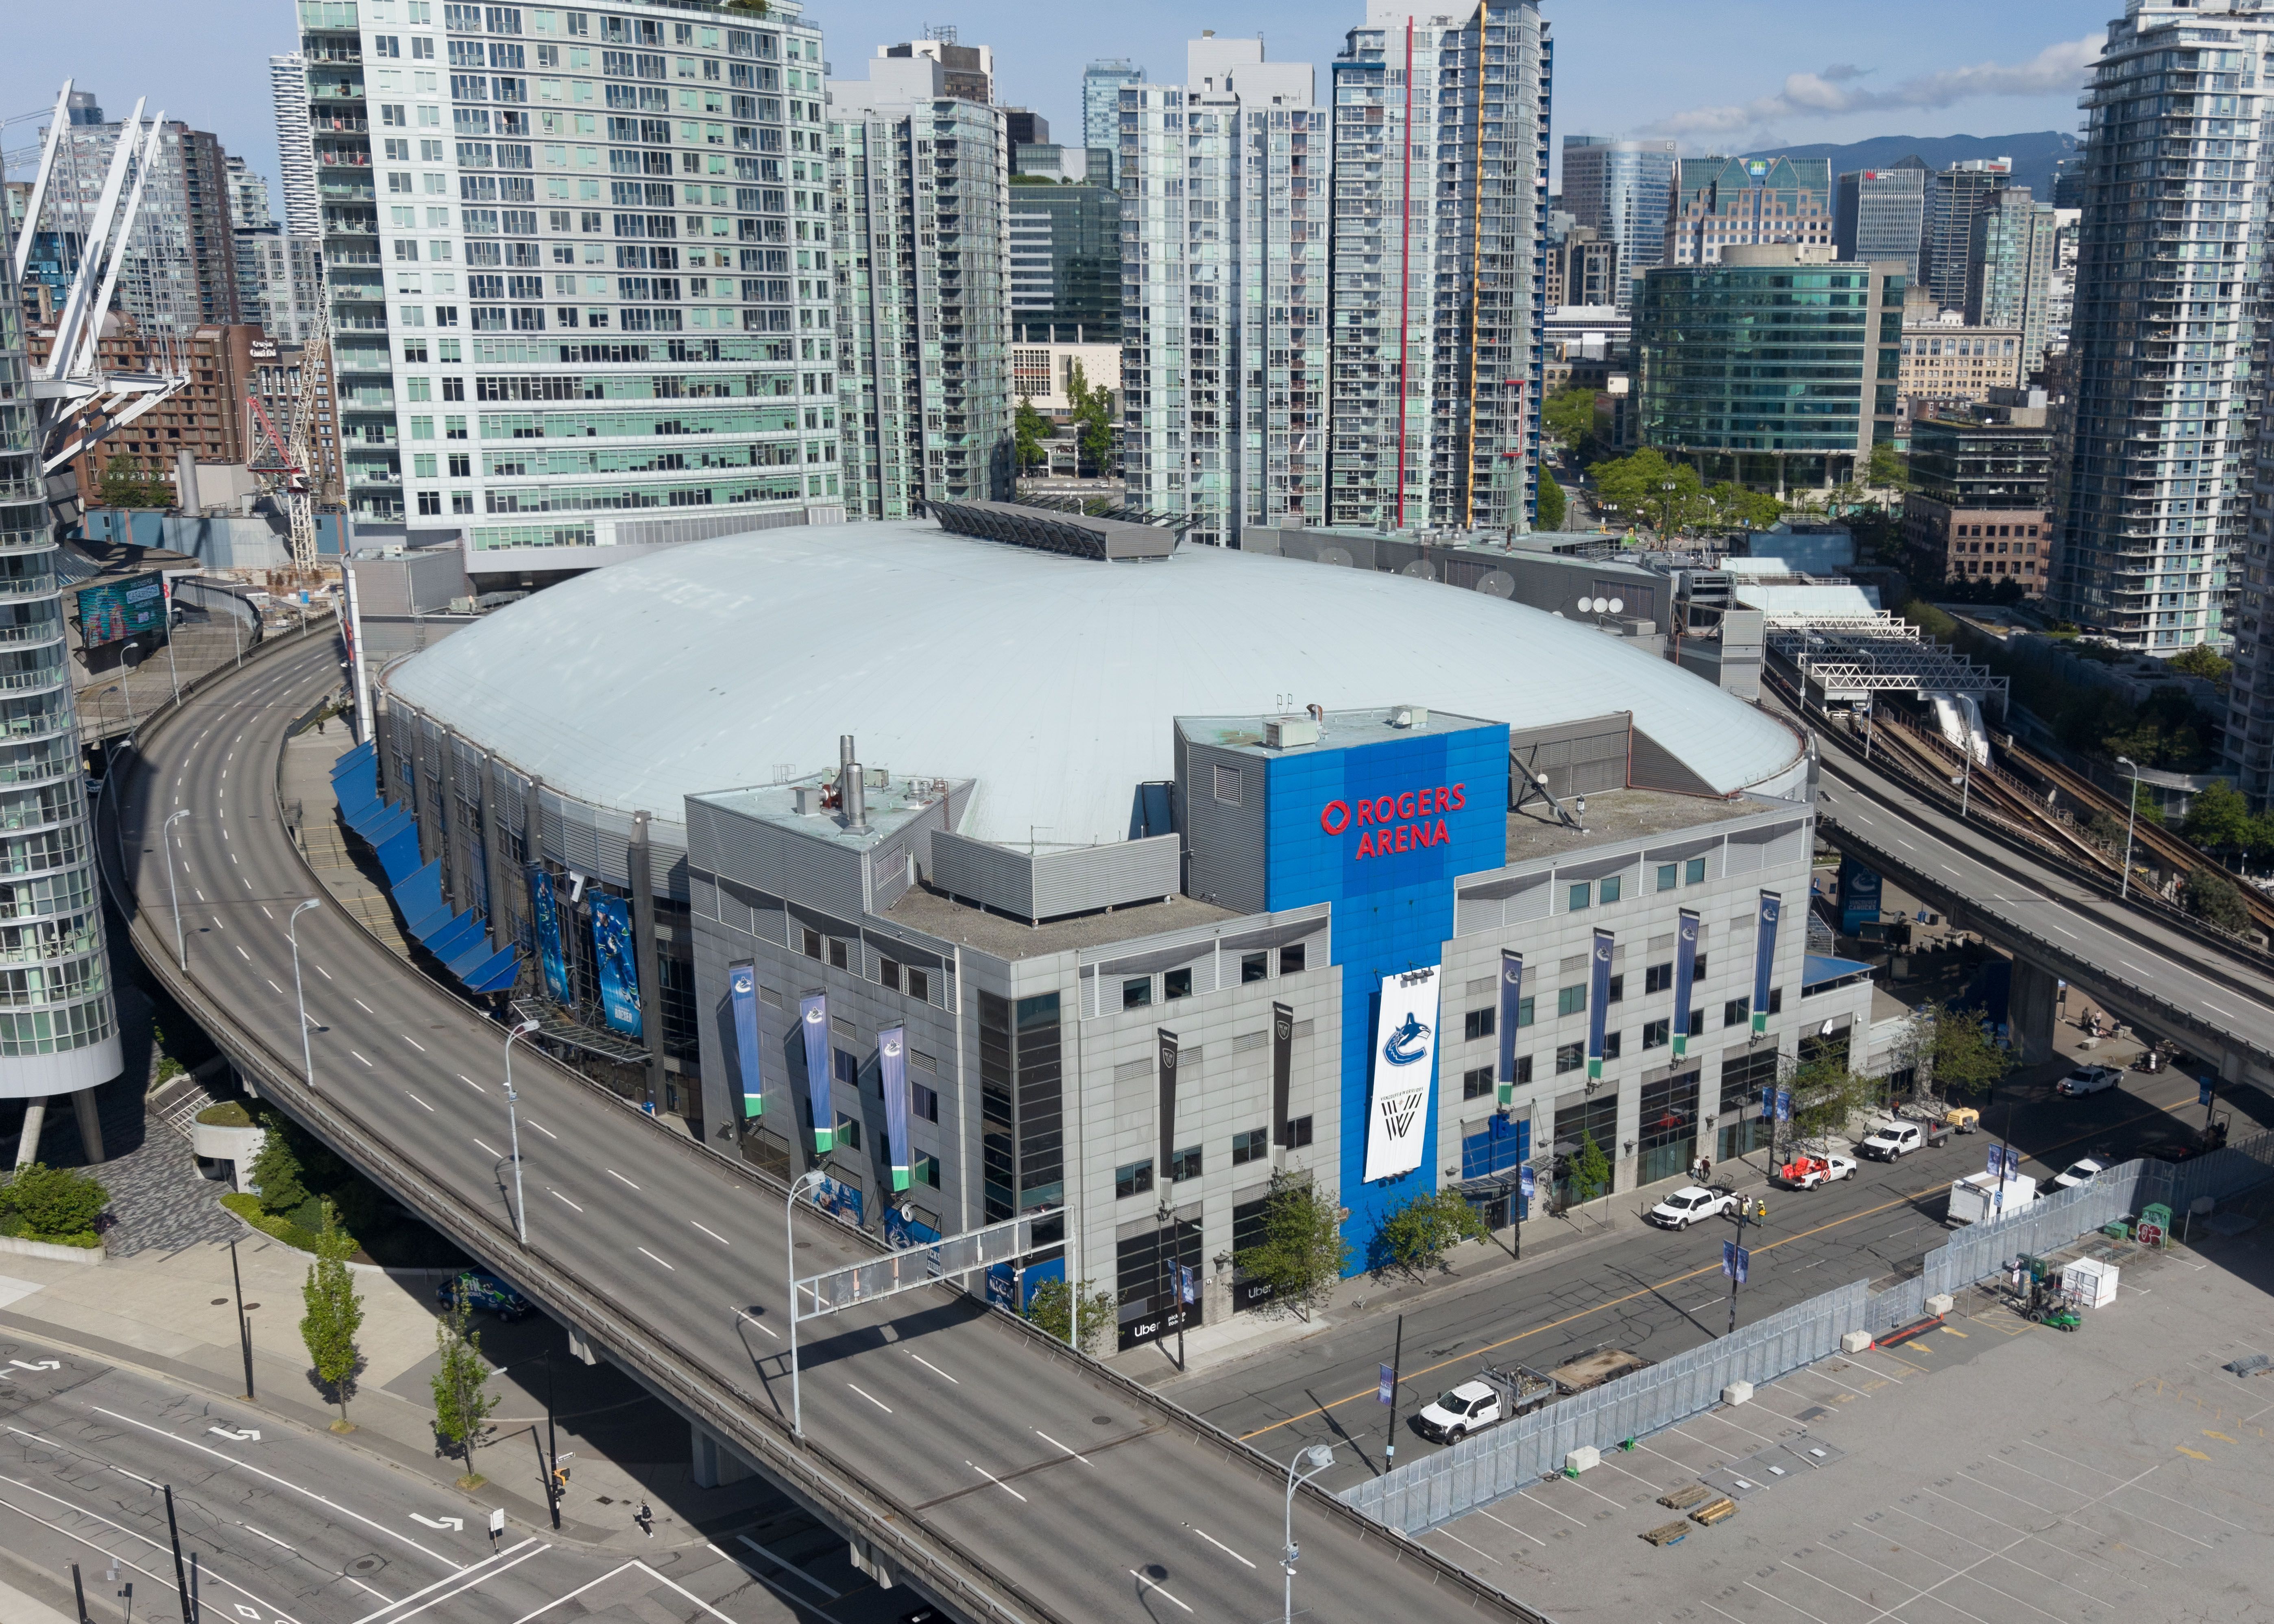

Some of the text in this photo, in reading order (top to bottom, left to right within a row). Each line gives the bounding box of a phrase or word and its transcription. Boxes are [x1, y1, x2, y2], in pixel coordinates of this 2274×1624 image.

[1357, 783, 1465, 826] ROGERS
[1356, 819, 1450, 861] ARENA
[570, 871, 585, 902] 7
[1822, 1019, 1833, 1034] 4
[1249, 1284, 1272, 1298] Uber
[1135, 1321, 1160, 1337] Uber
